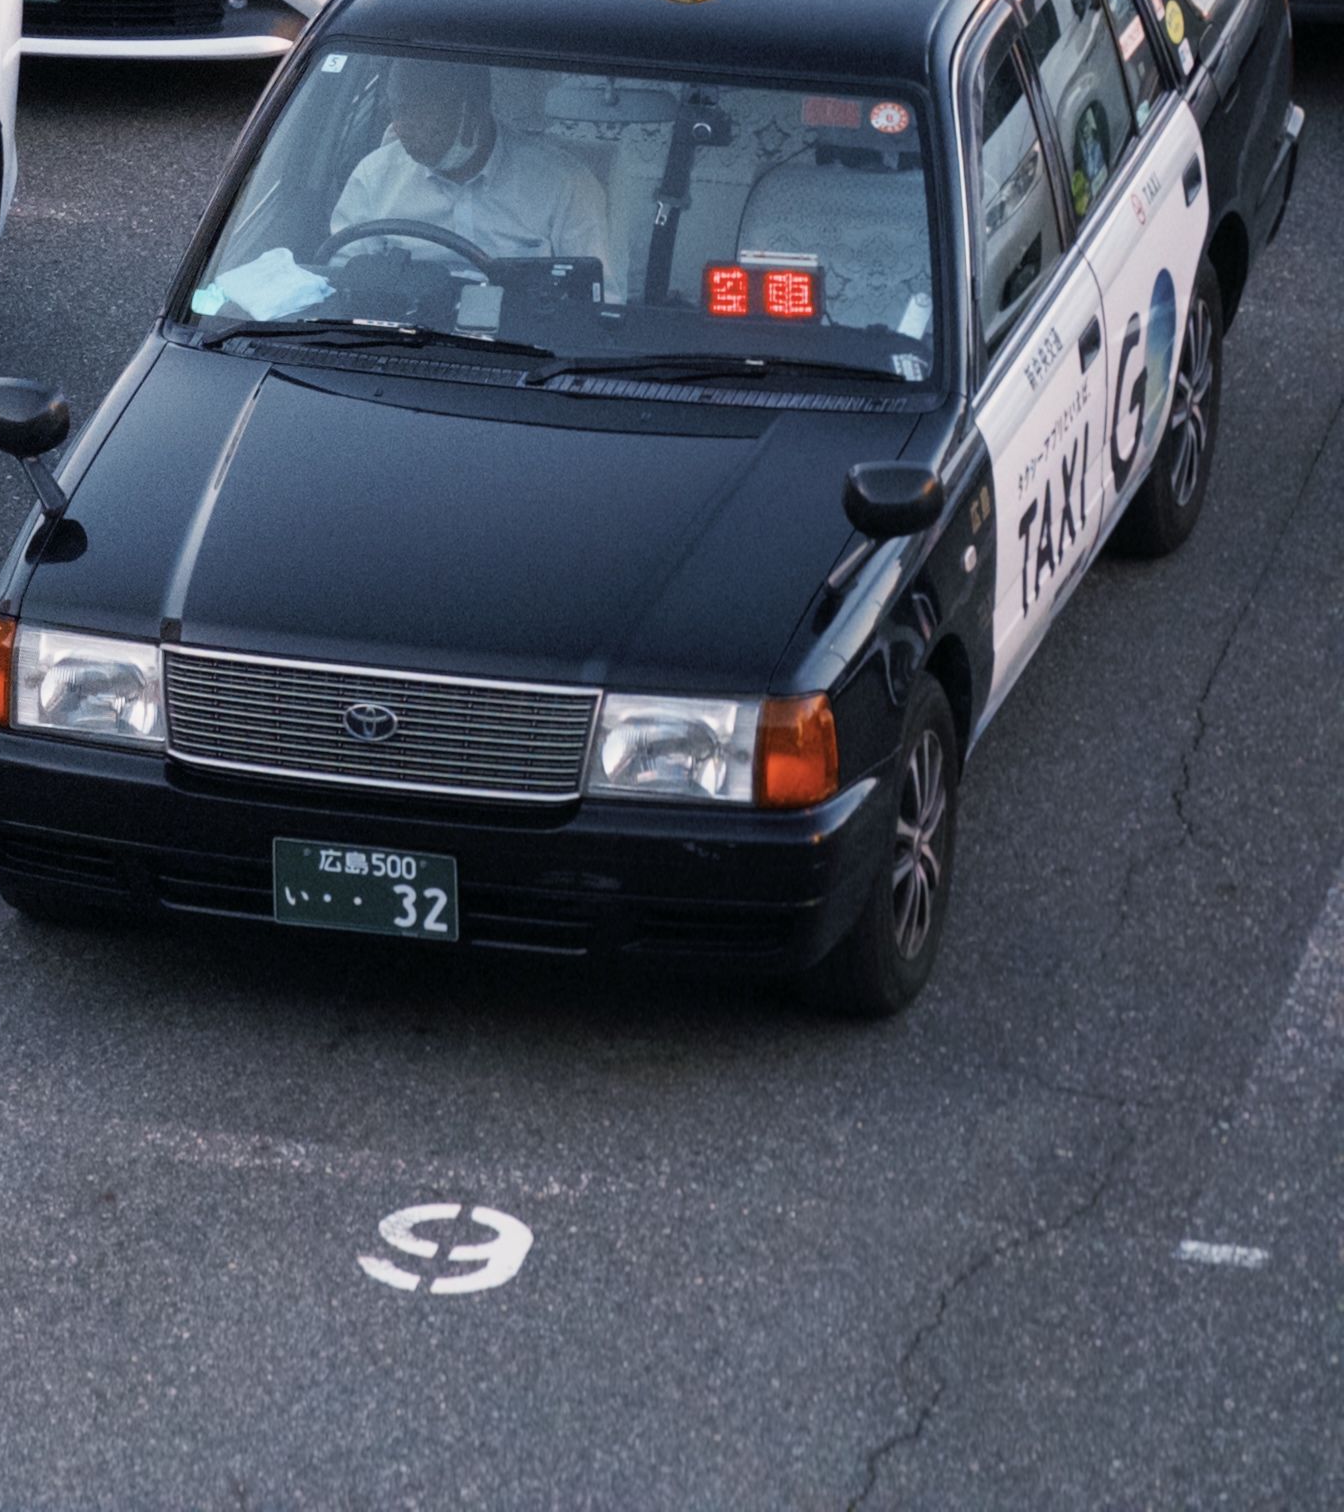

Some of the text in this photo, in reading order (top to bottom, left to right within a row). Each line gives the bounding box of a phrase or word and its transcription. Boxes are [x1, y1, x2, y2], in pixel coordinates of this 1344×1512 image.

[1018, 420, 1091, 618] TAXI
[318, 849, 417, 880] 広島500
[284, 884, 449, 933] い 32
